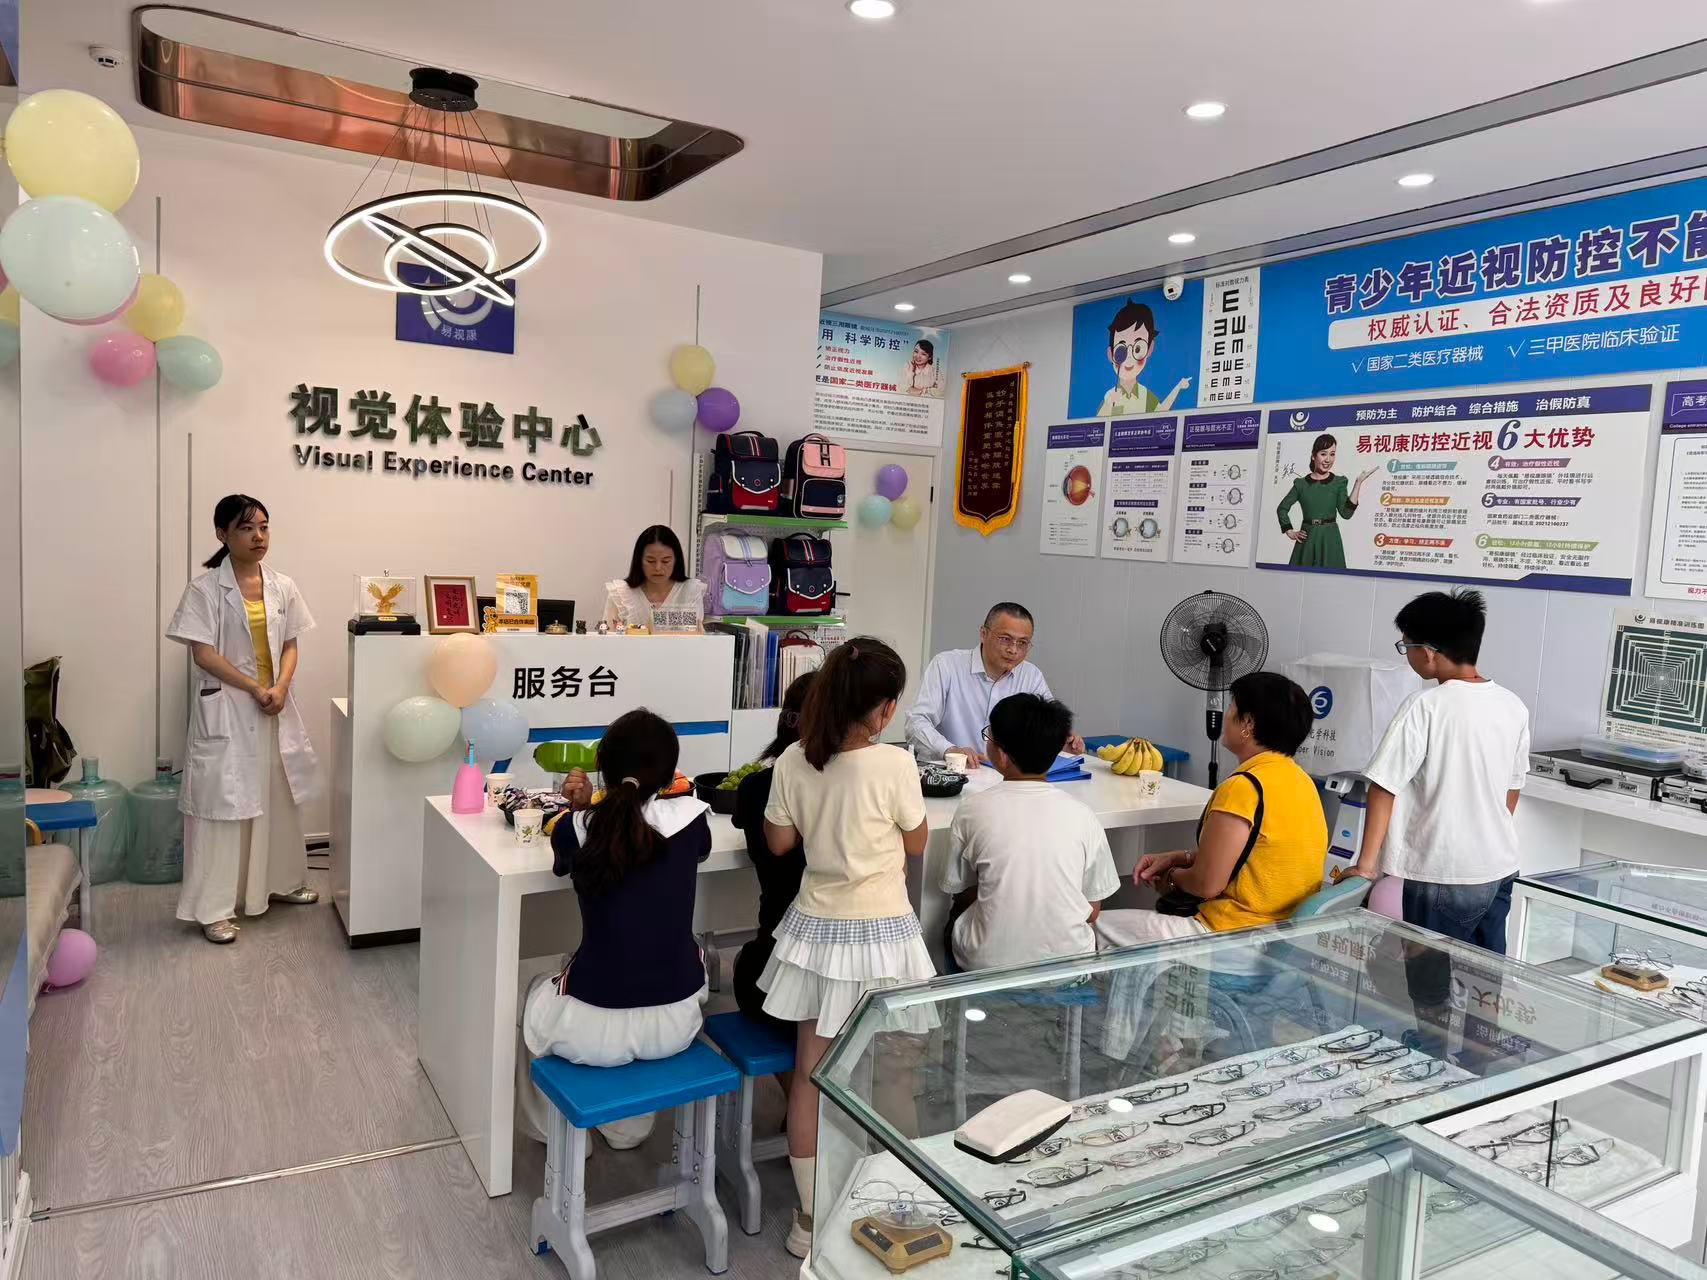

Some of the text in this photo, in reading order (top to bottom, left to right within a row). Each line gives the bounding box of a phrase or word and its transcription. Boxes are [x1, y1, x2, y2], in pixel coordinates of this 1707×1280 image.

[1368, 274, 1707, 342] 权威认证、合法资质及良好
[441, 324, 478, 341] 易视康
[1528, 323, 1680, 356] 三甲医院临床验证
[1366, 345, 1484, 373] 国家二类医疗器械
[288, 383, 603, 457] 视觉体验中心
[1356, 396, 1591, 421] 预防为主 防护结合 综合措施 治假防真
[293, 443, 594, 486] Visual Experience Center
[512, 665, 619, 699] 服务台
